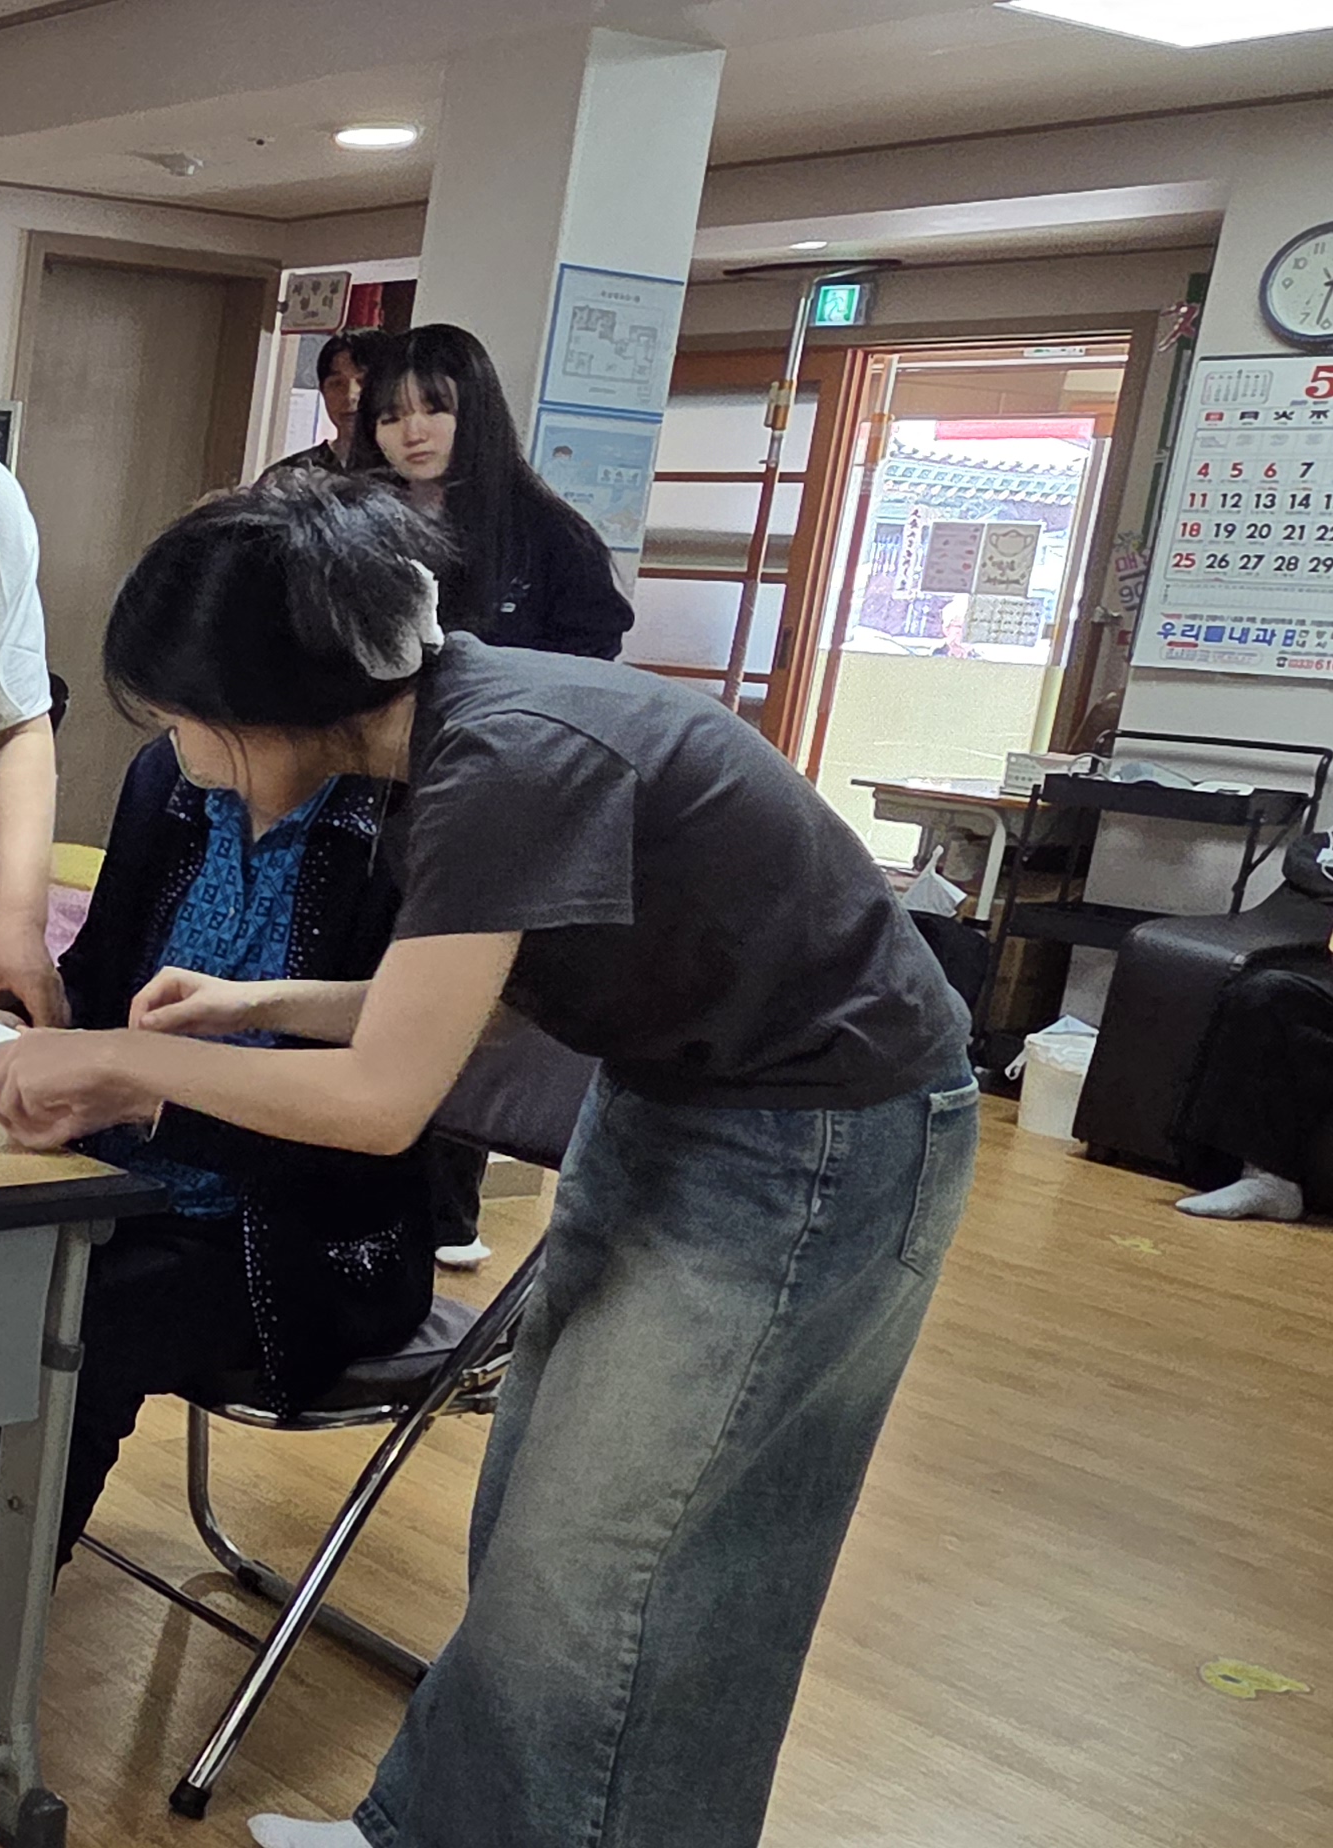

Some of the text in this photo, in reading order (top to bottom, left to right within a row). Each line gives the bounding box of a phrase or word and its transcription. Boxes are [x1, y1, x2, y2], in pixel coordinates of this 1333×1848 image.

[1300, 312, 1311, 324] 7
[1305, 365, 1333, 399] 5
[1197, 462, 1314, 478] 4 5 6 7
[1189, 493, 1208, 508] 11
[1220, 493, 1242, 508] 12
[1255, 493, 1277, 509] 13
[1289, 494, 1311, 509] 14
[1181, 522, 1201, 538] 18
[1214, 523, 1237, 539] 19
[1246, 523, 1272, 539] 20
[1282, 525, 1306, 540] 21
[1172, 553, 1196, 568] 25
[1205, 554, 1230, 569] 26
[1238, 554, 1265, 570] 27
[1273, 555, 1299, 571] 28
